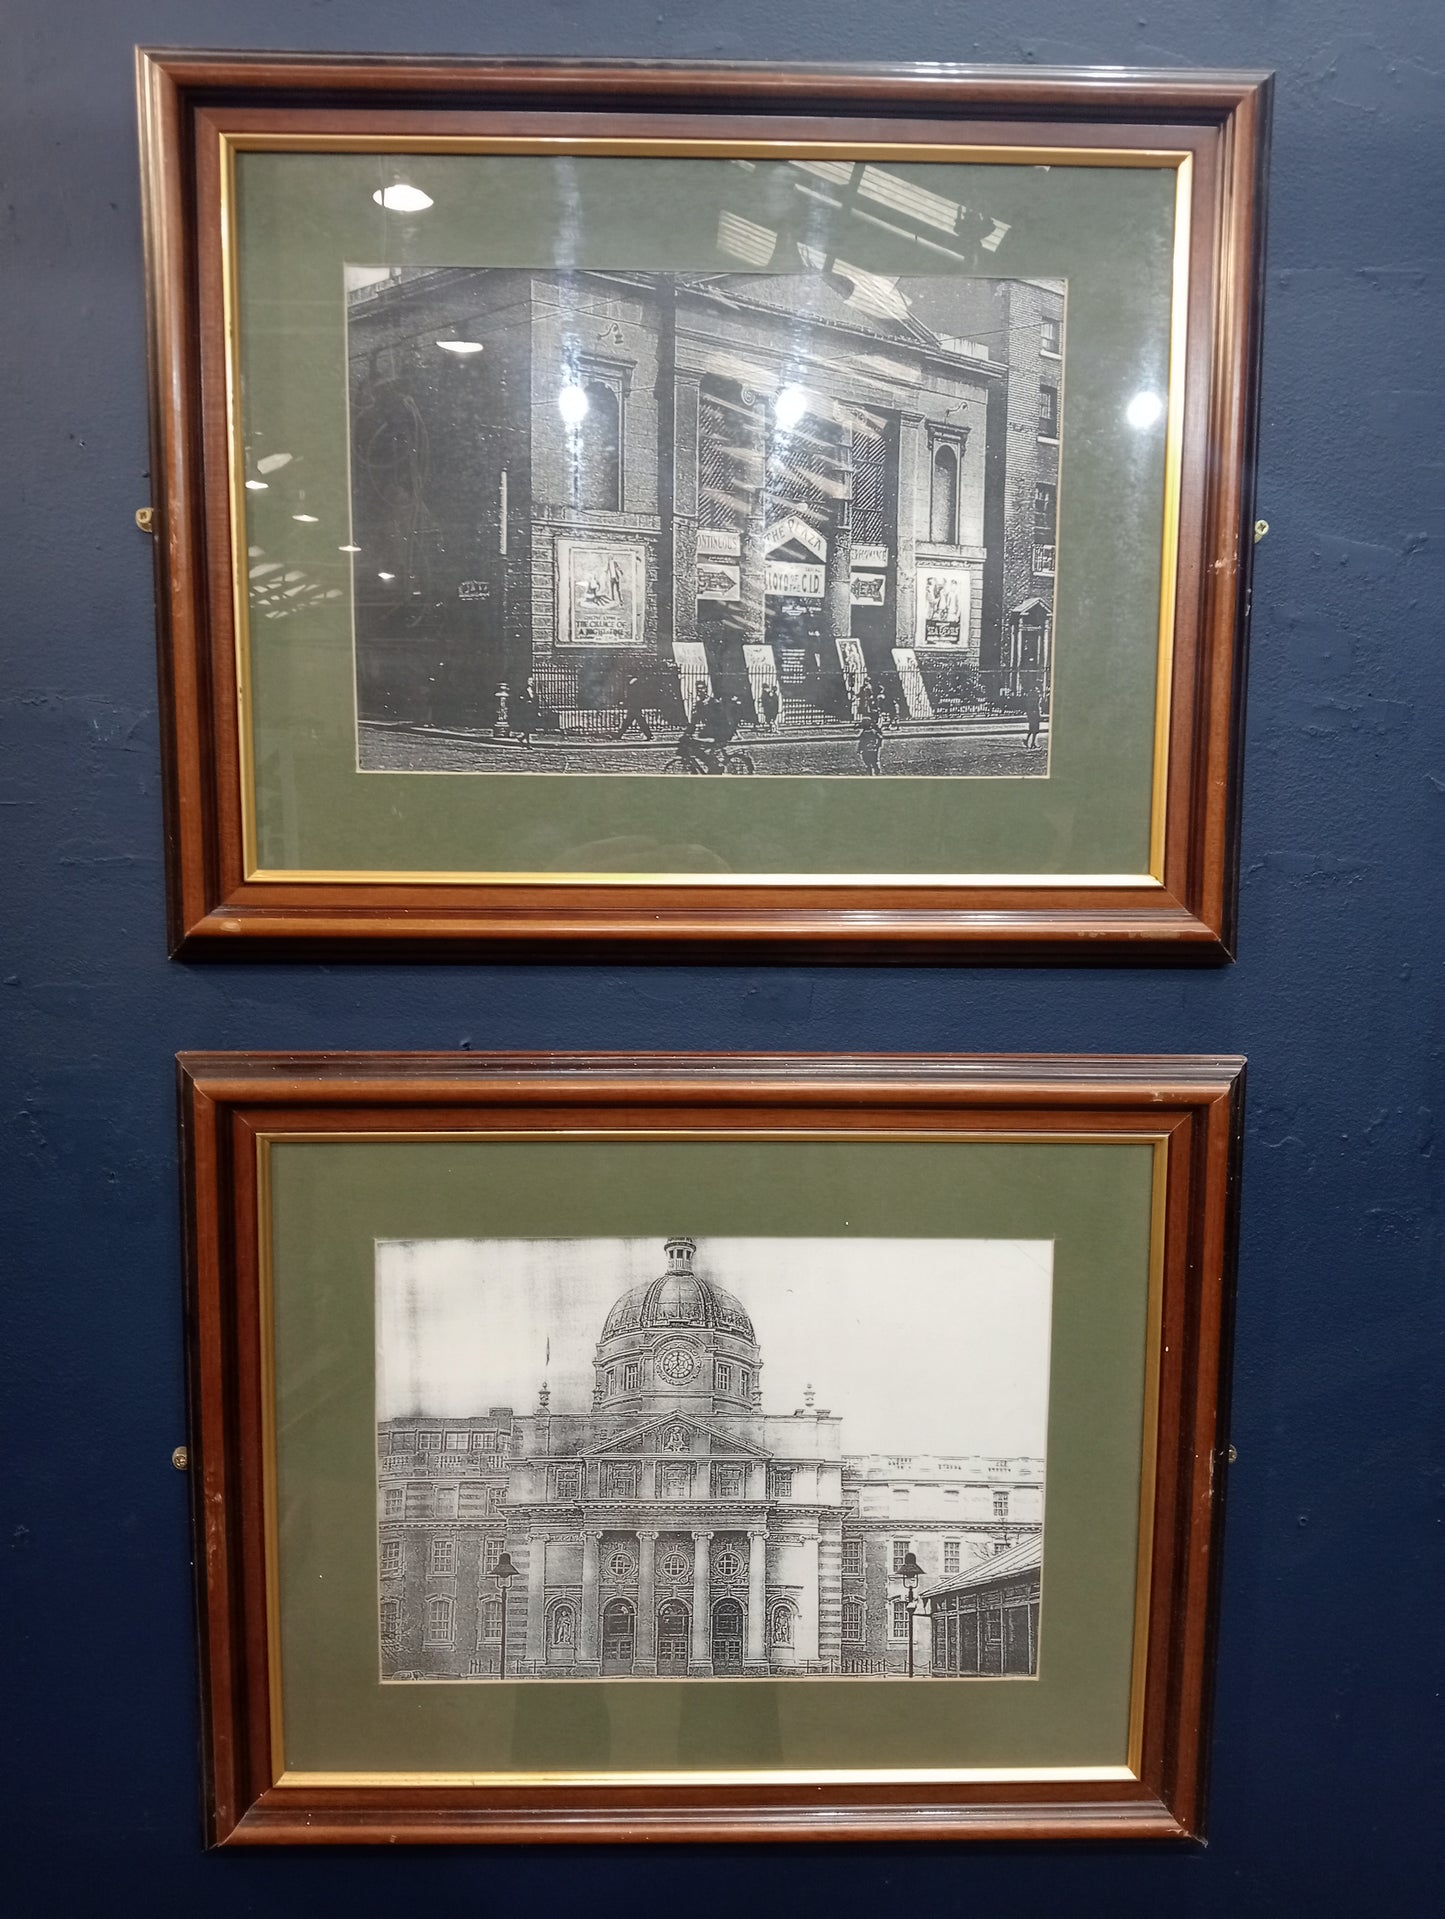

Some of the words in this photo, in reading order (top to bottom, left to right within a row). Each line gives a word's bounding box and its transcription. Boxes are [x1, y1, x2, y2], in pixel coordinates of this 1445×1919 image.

[696, 534, 738, 550] ONTINUOUS
[763, 526, 786, 543] THE
[787, 518, 821, 552] PLAZA
